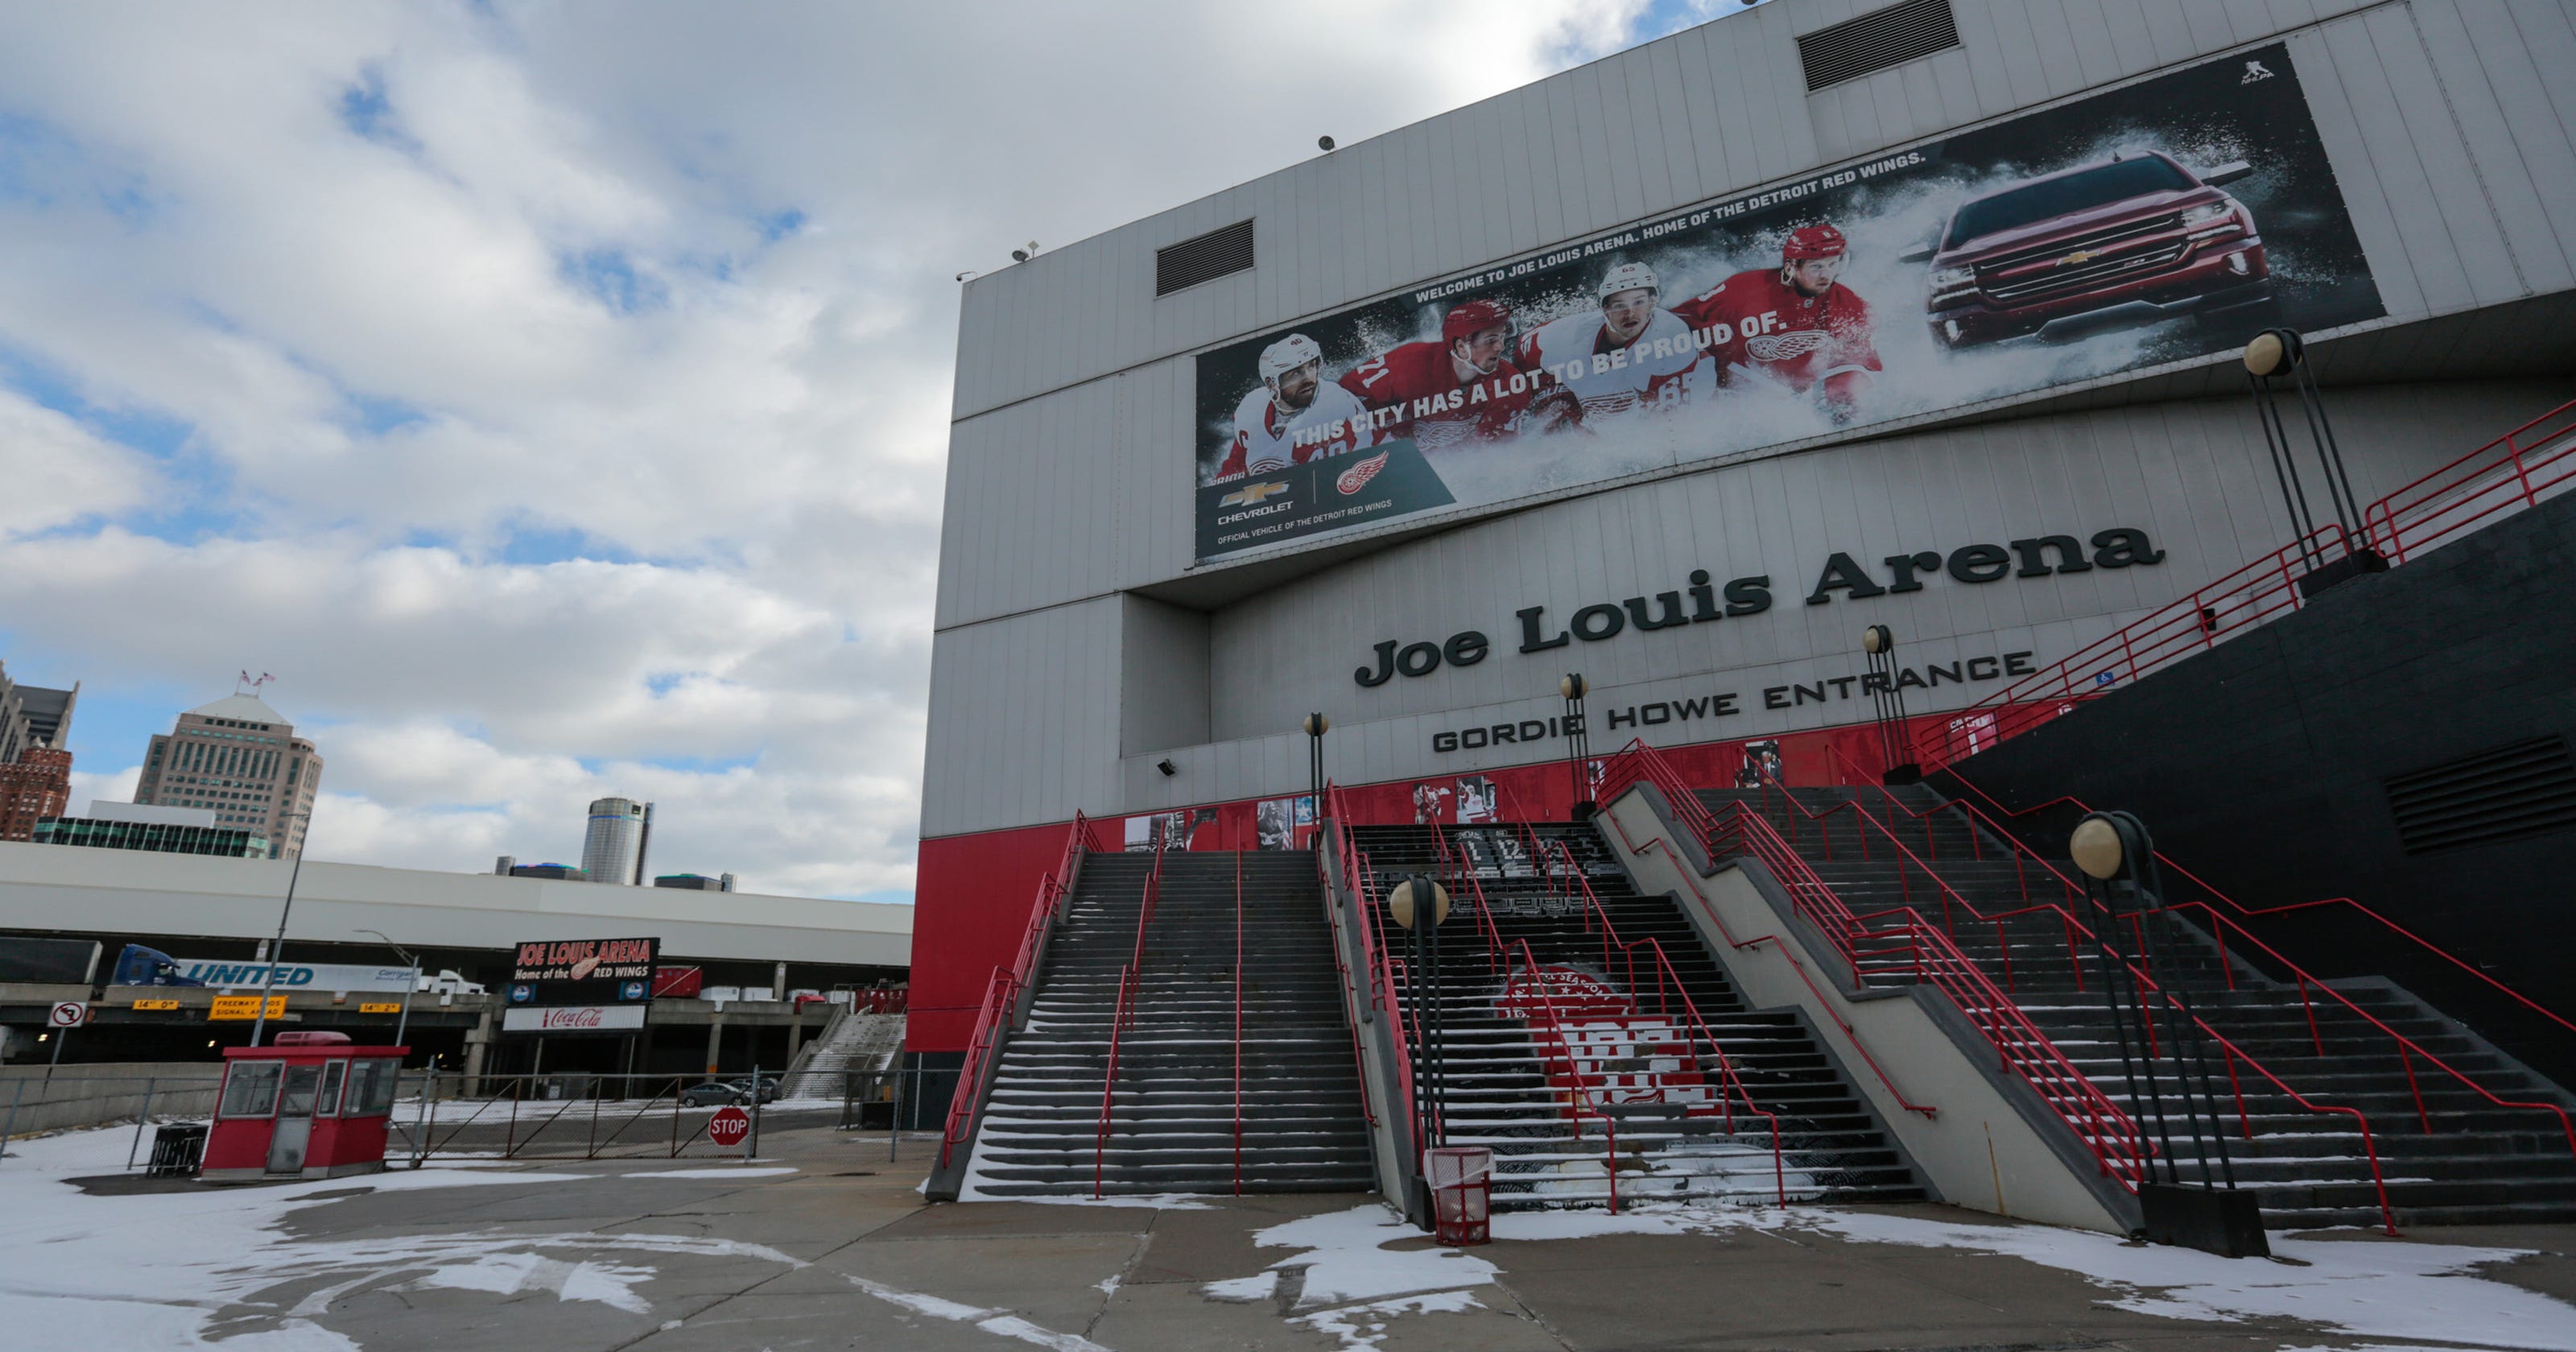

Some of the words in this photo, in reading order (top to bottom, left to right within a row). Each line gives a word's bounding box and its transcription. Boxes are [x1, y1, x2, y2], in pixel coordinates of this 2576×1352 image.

[1415, 274, 1484, 303] WELCOME
[1488, 270, 1505, 284] TO
[1508, 261, 1535, 278] JOE
[1538, 248, 1581, 269] LOUIS
[1584, 233, 1640, 257] ARENA.
[1642, 221, 1687, 240] HOME
[1690, 211, 1711, 227] OF
[1713, 201, 1746, 220] THE
[1748, 181, 1818, 210] DETROIT
[1822, 171, 1856, 190] RED
[1859, 151, 1926, 179] WINGS.
[1292, 418, 1345, 448] THIS
[1351, 402, 1408, 435] CITY
[1413, 388, 1464, 419] HAS
[1470, 383, 1488, 403] A
[1493, 369, 1543, 399] LOT
[1548, 358, 1584, 384] TO
[1591, 349, 1628, 375] BE
[1634, 322, 1733, 365] PROUD
[1740, 310, 1787, 339] OF.
[1217, 501, 1294, 526] CHEVROLET
[1217, 530, 1250, 545] OFFICIAL
[1251, 523, 1283, 538] VEHICLE
[1285, 520, 1295, 530] OF
[1296, 516, 1312, 526] THE
[1313, 509, 1346, 525] DETROIT
[1347, 505, 1364, 517] RED
[1364, 499, 1393, 513] WINGS
[1354, 630, 1489, 687] Joe
[1516, 569, 1772, 654] Louis
[1806, 527, 2166, 606] Arena
[1433, 714, 1587, 753] GORDIE
[1608, 692, 1740, 730] HOWE
[1763, 650, 2037, 710] ENTRANCE
[517, 944, 547, 966] JOE
[547, 941, 595, 965] LOUIS
[598, 940, 650, 963] ARENA
[188, 964, 313, 985] UNITED
[514, 968, 541, 980] Home
[543, 967, 554, 979] of
[555, 967, 569, 979] the
[593, 967, 612, 978] RED
[615, 966, 648, 978] WINGS
[712, 1119, 747, 1134] STOP
